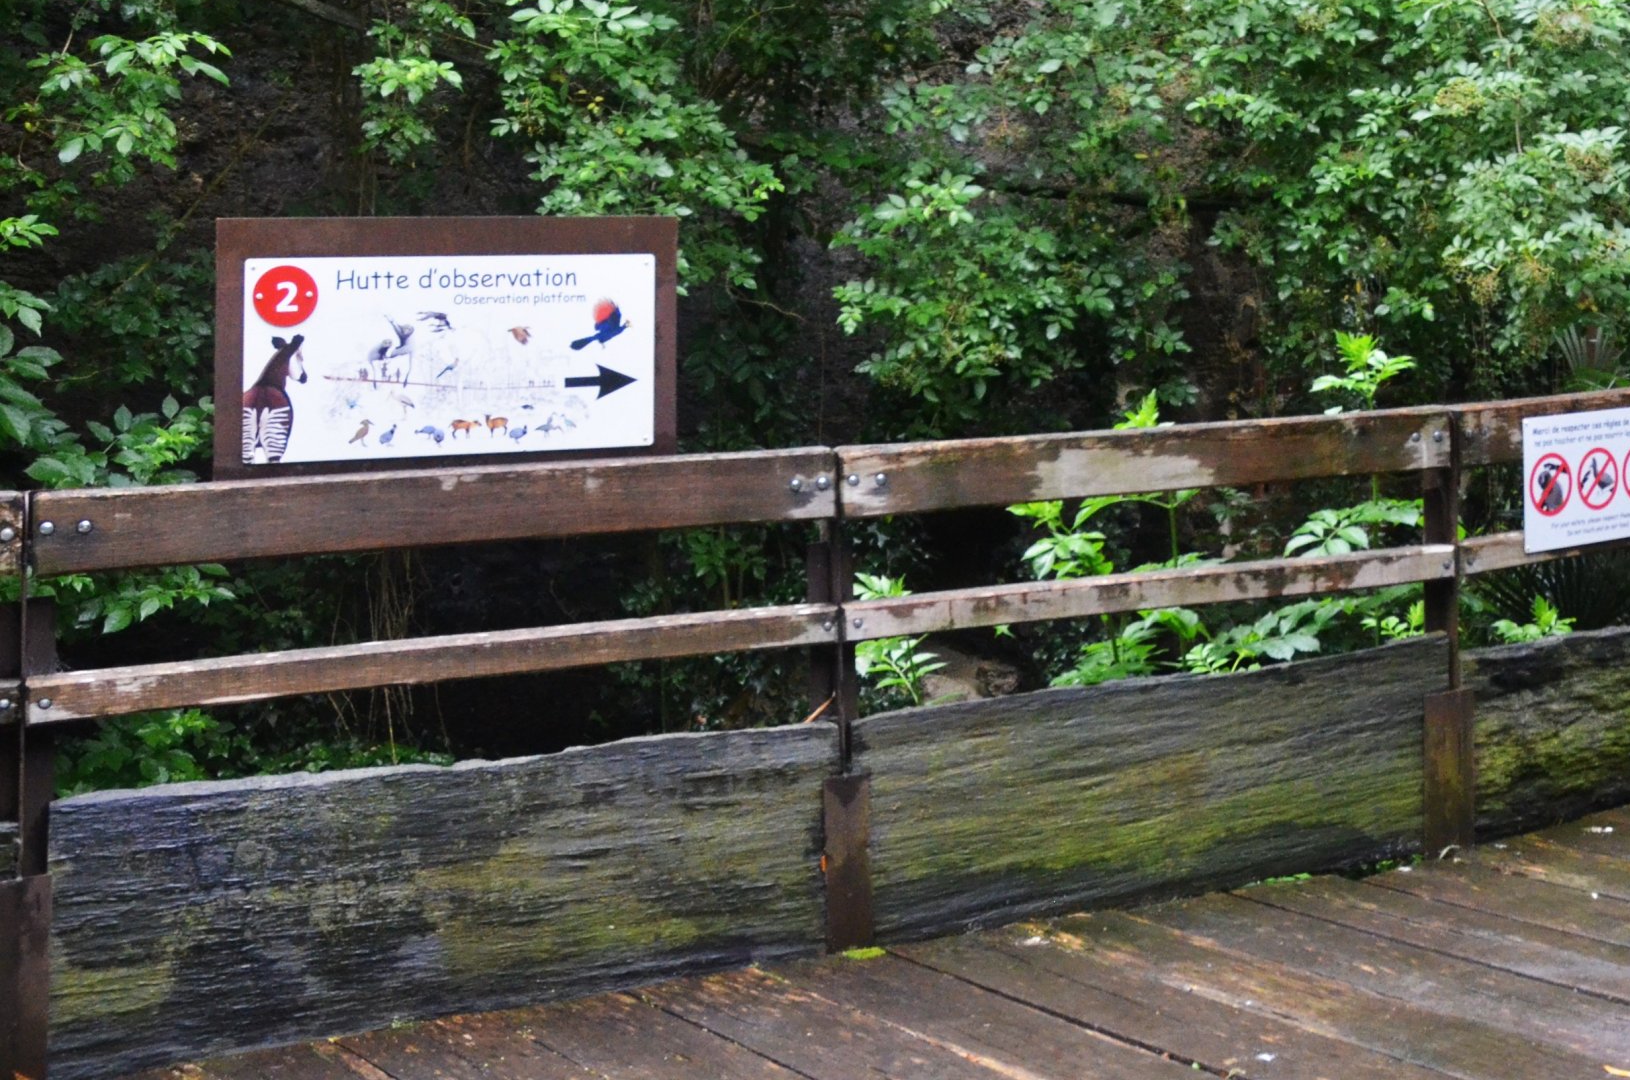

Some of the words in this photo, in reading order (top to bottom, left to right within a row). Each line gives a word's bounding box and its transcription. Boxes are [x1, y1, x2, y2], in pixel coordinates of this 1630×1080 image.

[336, 269, 410, 290] Hutte
[418, 267, 578, 289] d'observation
[276, 281, 299, 312] 2
[453, 293, 530, 306] Observation
[533, 292, 587, 306] platform
[1533, 427, 1550, 436] Merci
[1552, 426, 1559, 434] de
[1560, 423, 1590, 433] respecter
[1543, 440, 1552, 448] pas
[1554, 436, 1576, 445] toucher
[1593, 433, 1602, 442] pas
[1604, 431, 1624, 439] nourrir
